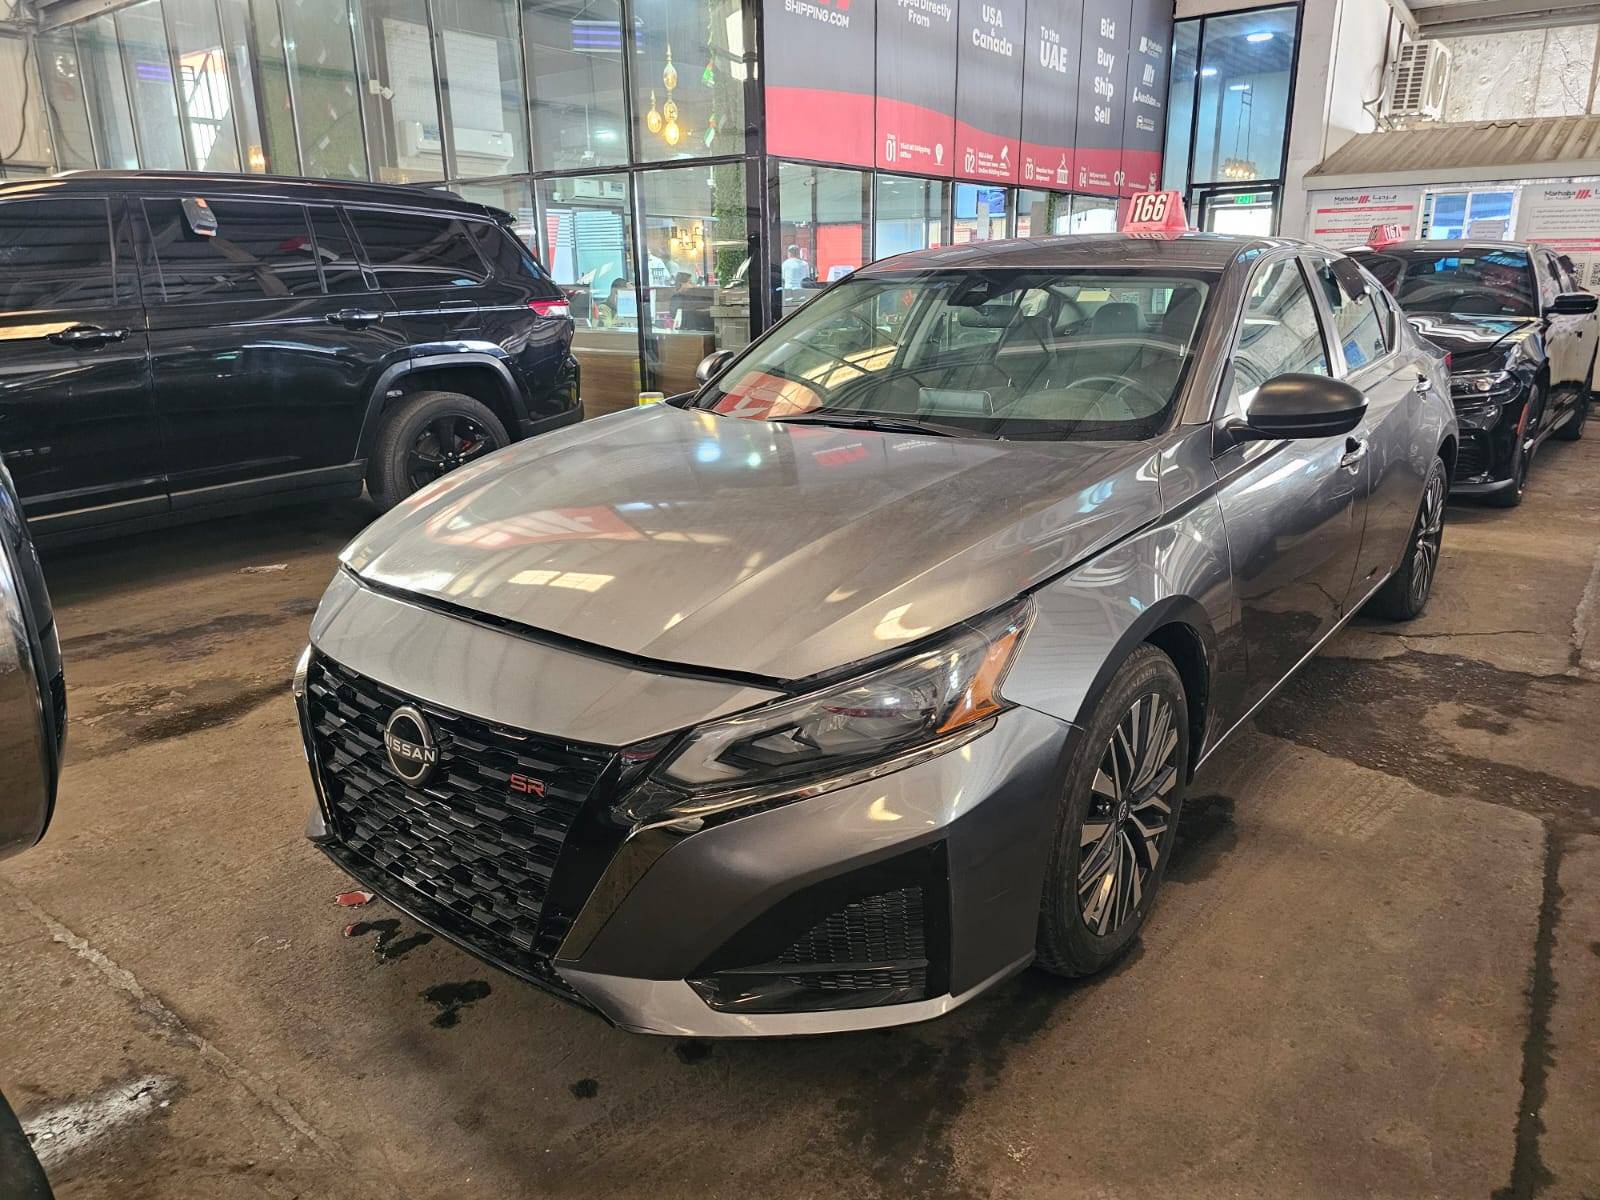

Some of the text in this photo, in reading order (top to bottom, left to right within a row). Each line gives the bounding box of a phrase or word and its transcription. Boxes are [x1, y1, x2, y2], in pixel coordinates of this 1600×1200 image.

[784, 0, 850, 28] SHIPPING.COM
[908, 9, 930, 28] From
[920, 0, 952, 22] Directly
[982, 4, 1003, 28] USA
[1041, 26, 1060, 44] To the
[1100, 18, 1116, 40] Bid
[972, 28, 1013, 57] Canada
[1040, 40, 1068, 73] UAE
[1097, 47, 1115, 74] Buy
[1094, 76, 1114, 102] Ship
[1094, 105, 1111, 125] Sell
[886, 139, 897, 162] 01
[965, 153, 976, 173] 02
[1025, 162, 1034, 180] 03
[1079, 171, 1087, 188] 04
[1113, 170, 1125, 187] OR
[1132, 193, 1168, 223] 166
[1386, 224, 1400, 240] 167
[383, 731, 436, 762] NISSAN
[509, 772, 546, 798] SR
